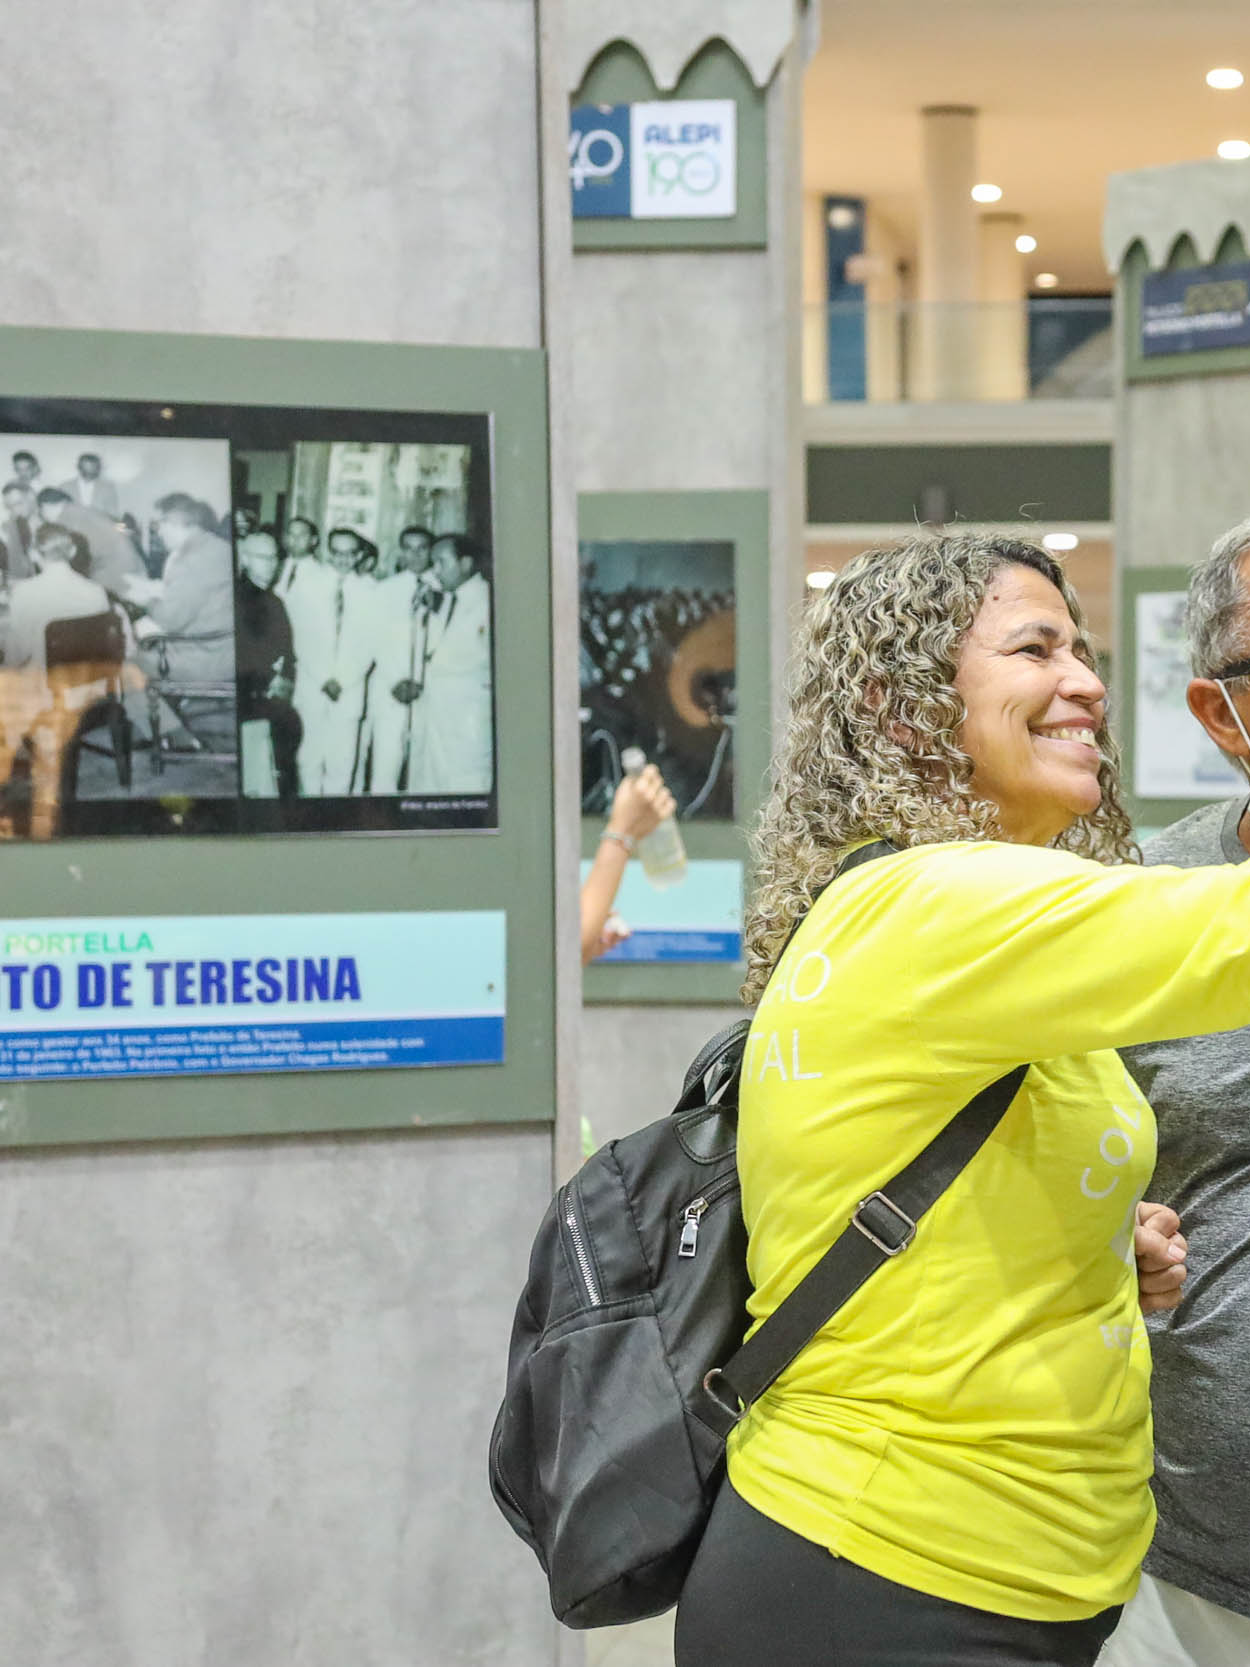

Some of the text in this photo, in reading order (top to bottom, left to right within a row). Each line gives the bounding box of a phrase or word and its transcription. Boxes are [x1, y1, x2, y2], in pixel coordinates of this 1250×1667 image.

[644, 123, 721, 144] ALEPI
[5, 931, 154, 954] PORTELLA
[2, 957, 361, 1010] TO DE TERESINA
